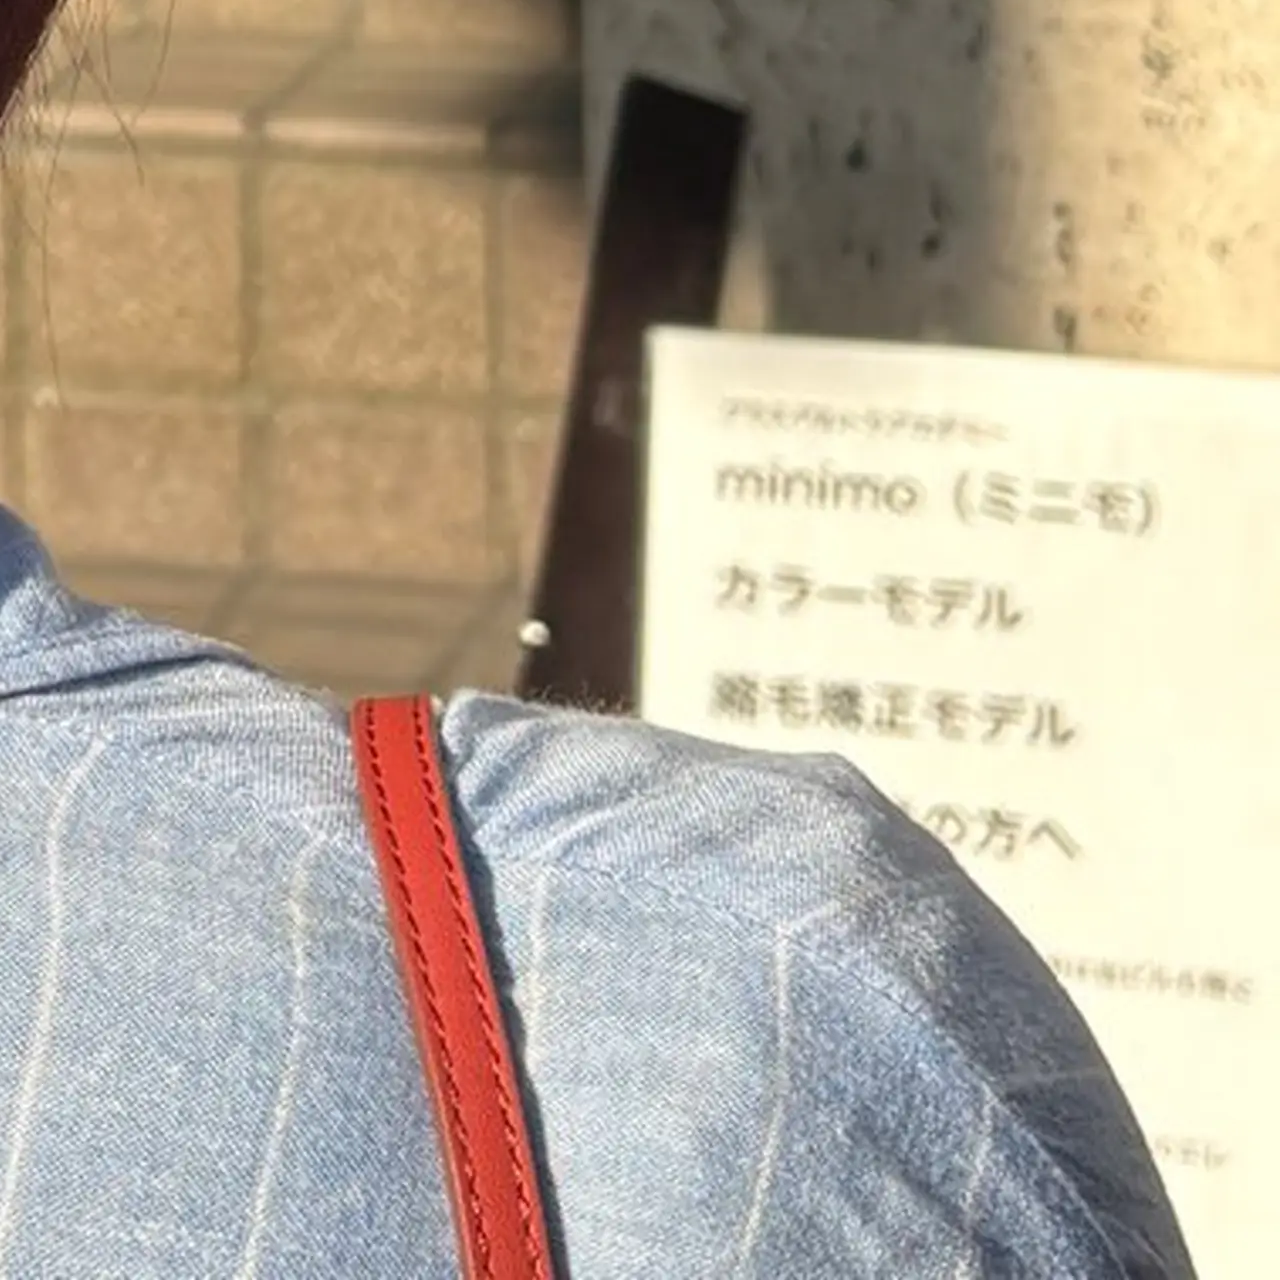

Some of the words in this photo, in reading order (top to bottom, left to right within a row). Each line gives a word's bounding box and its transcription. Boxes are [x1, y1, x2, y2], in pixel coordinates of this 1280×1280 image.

[716, 563, 1024, 635] カラーモデル
[896, 791, 1084, 862] の方へ
